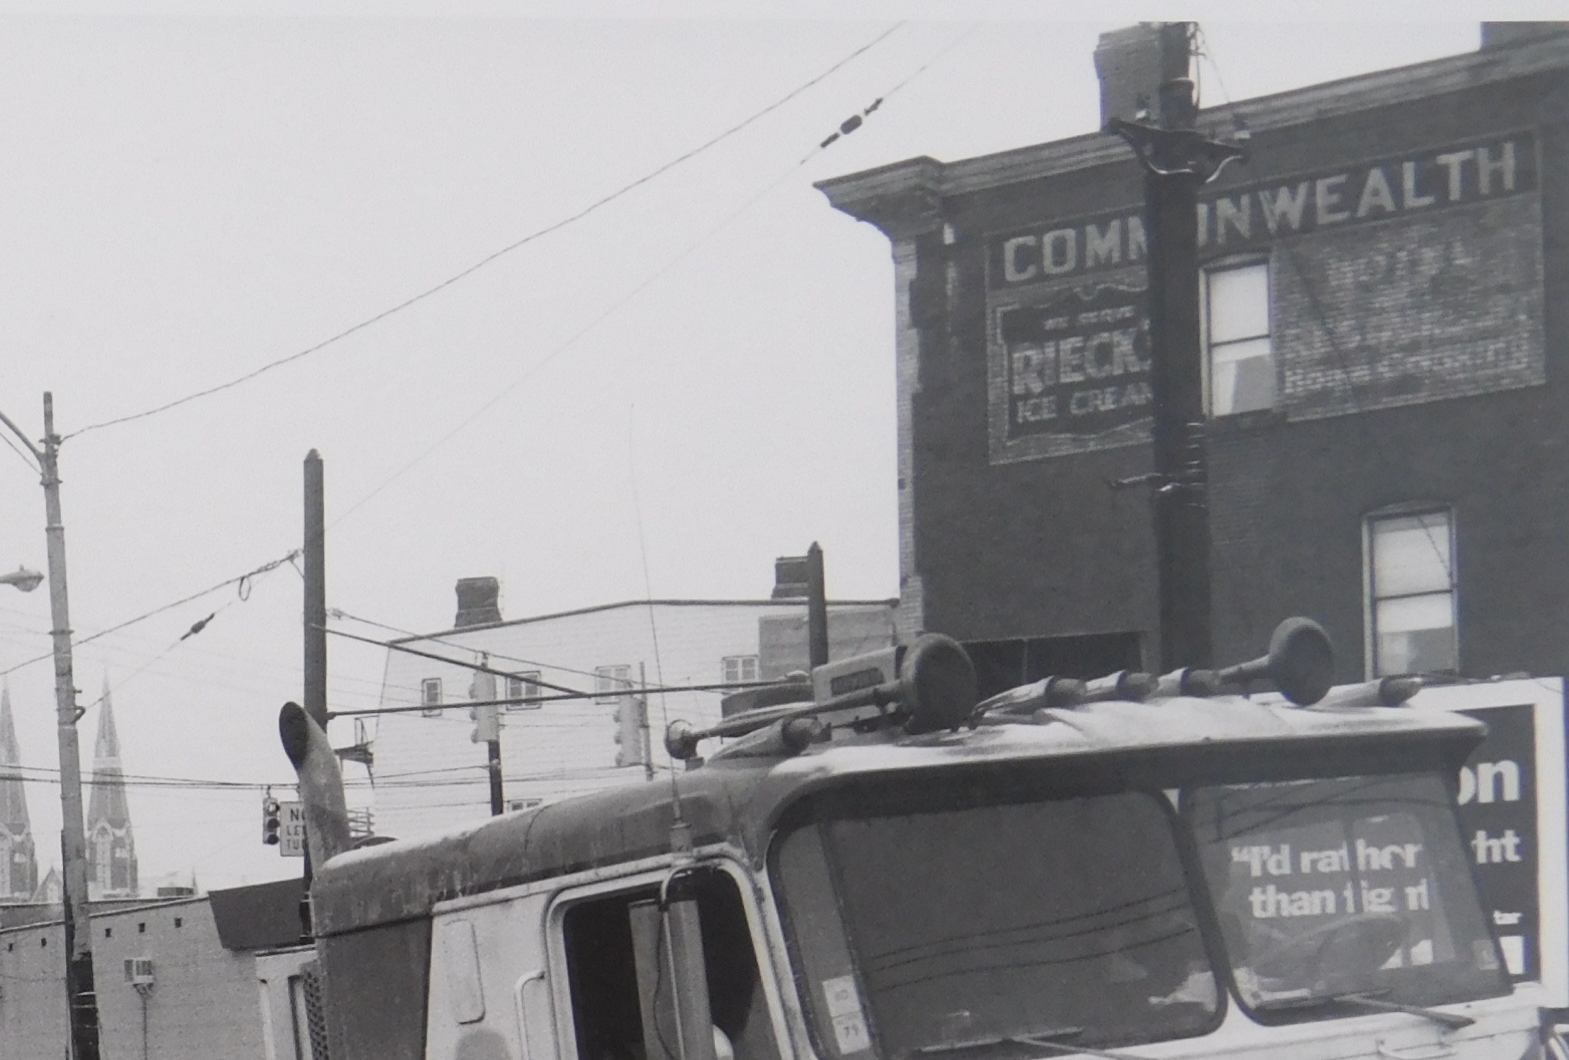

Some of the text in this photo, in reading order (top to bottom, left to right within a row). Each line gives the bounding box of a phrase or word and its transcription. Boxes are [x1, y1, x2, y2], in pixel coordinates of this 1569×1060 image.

[1004, 142, 1515, 281] COMMNWEALTH
[1016, 395, 1058, 424] ICE
[1300, 838, 1423, 874] rather
[1248, 884, 1337, 919] than
